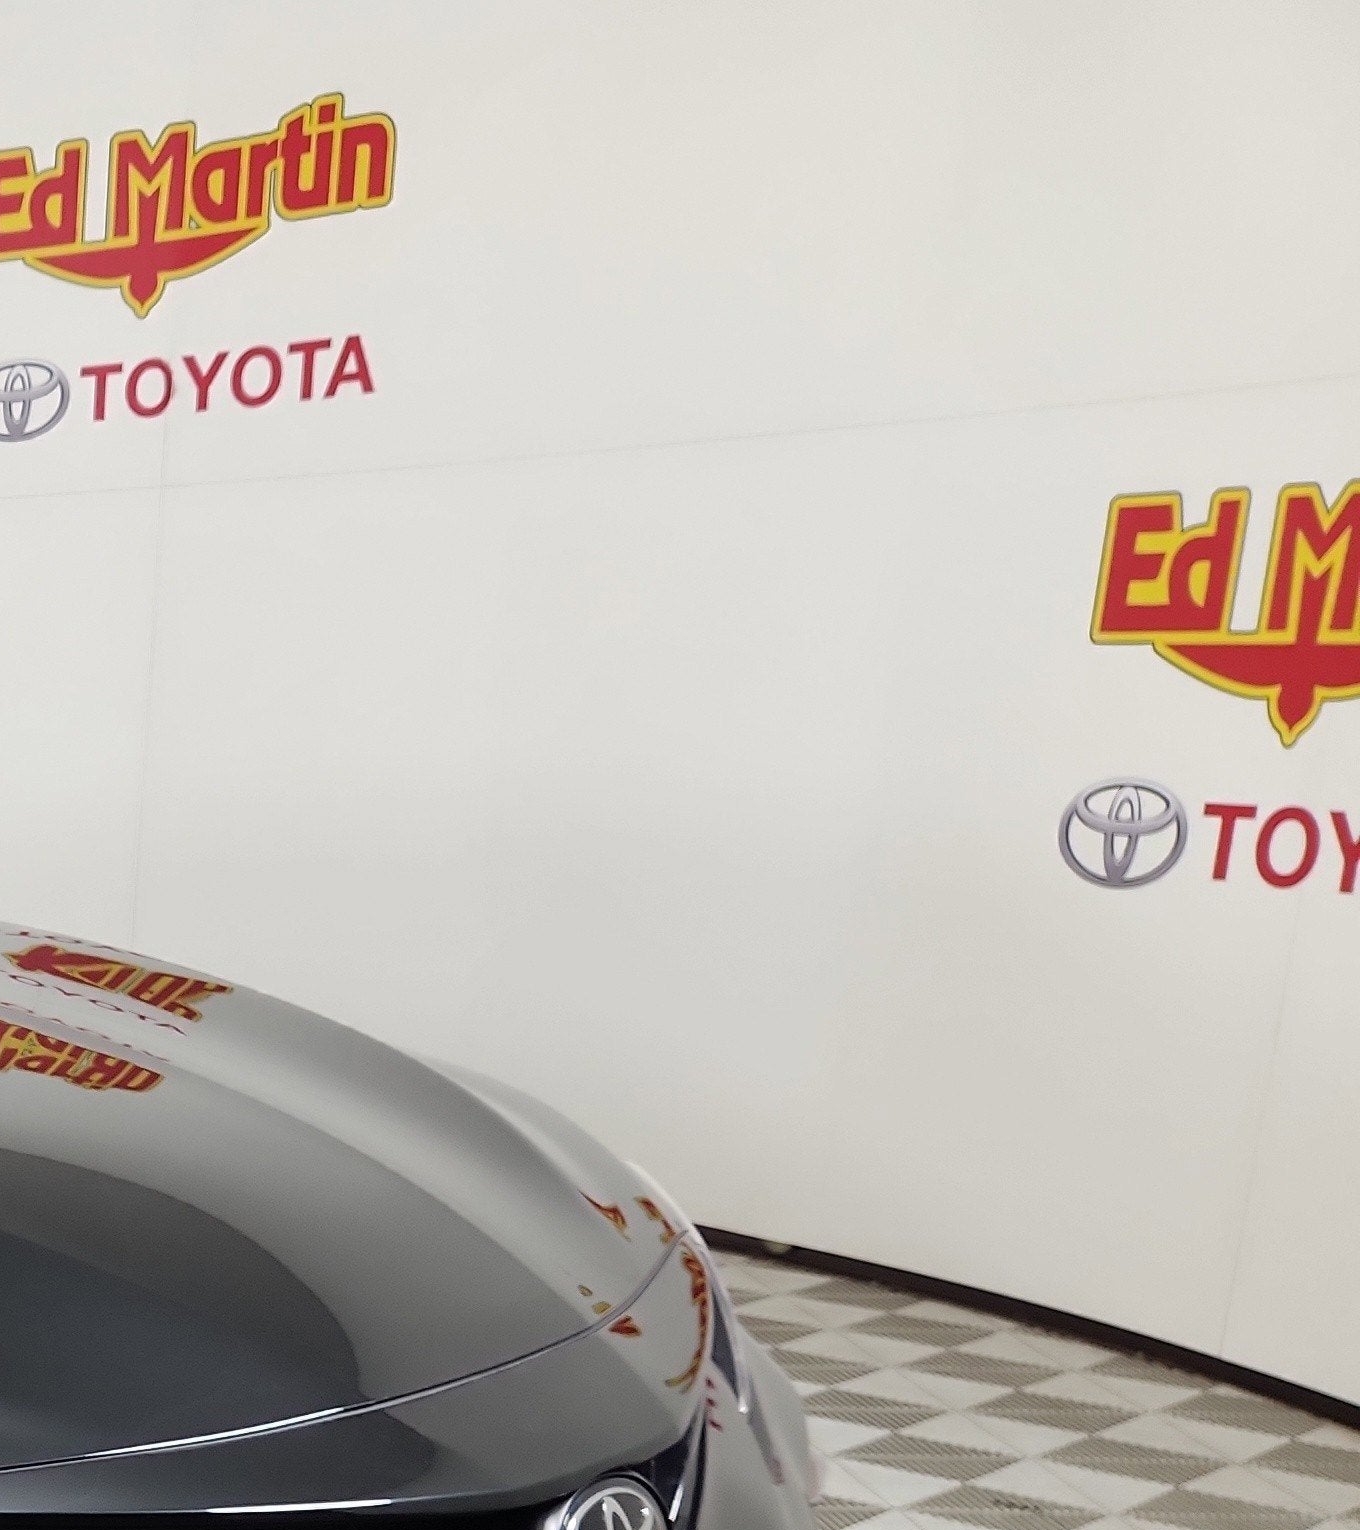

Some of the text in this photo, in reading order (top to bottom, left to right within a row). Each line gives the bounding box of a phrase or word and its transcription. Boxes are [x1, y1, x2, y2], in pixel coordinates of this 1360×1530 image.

[109, 94, 395, 241] Martin
[80, 335, 375, 422] TOYOTA
[1091, 488, 1250, 641] Ed
